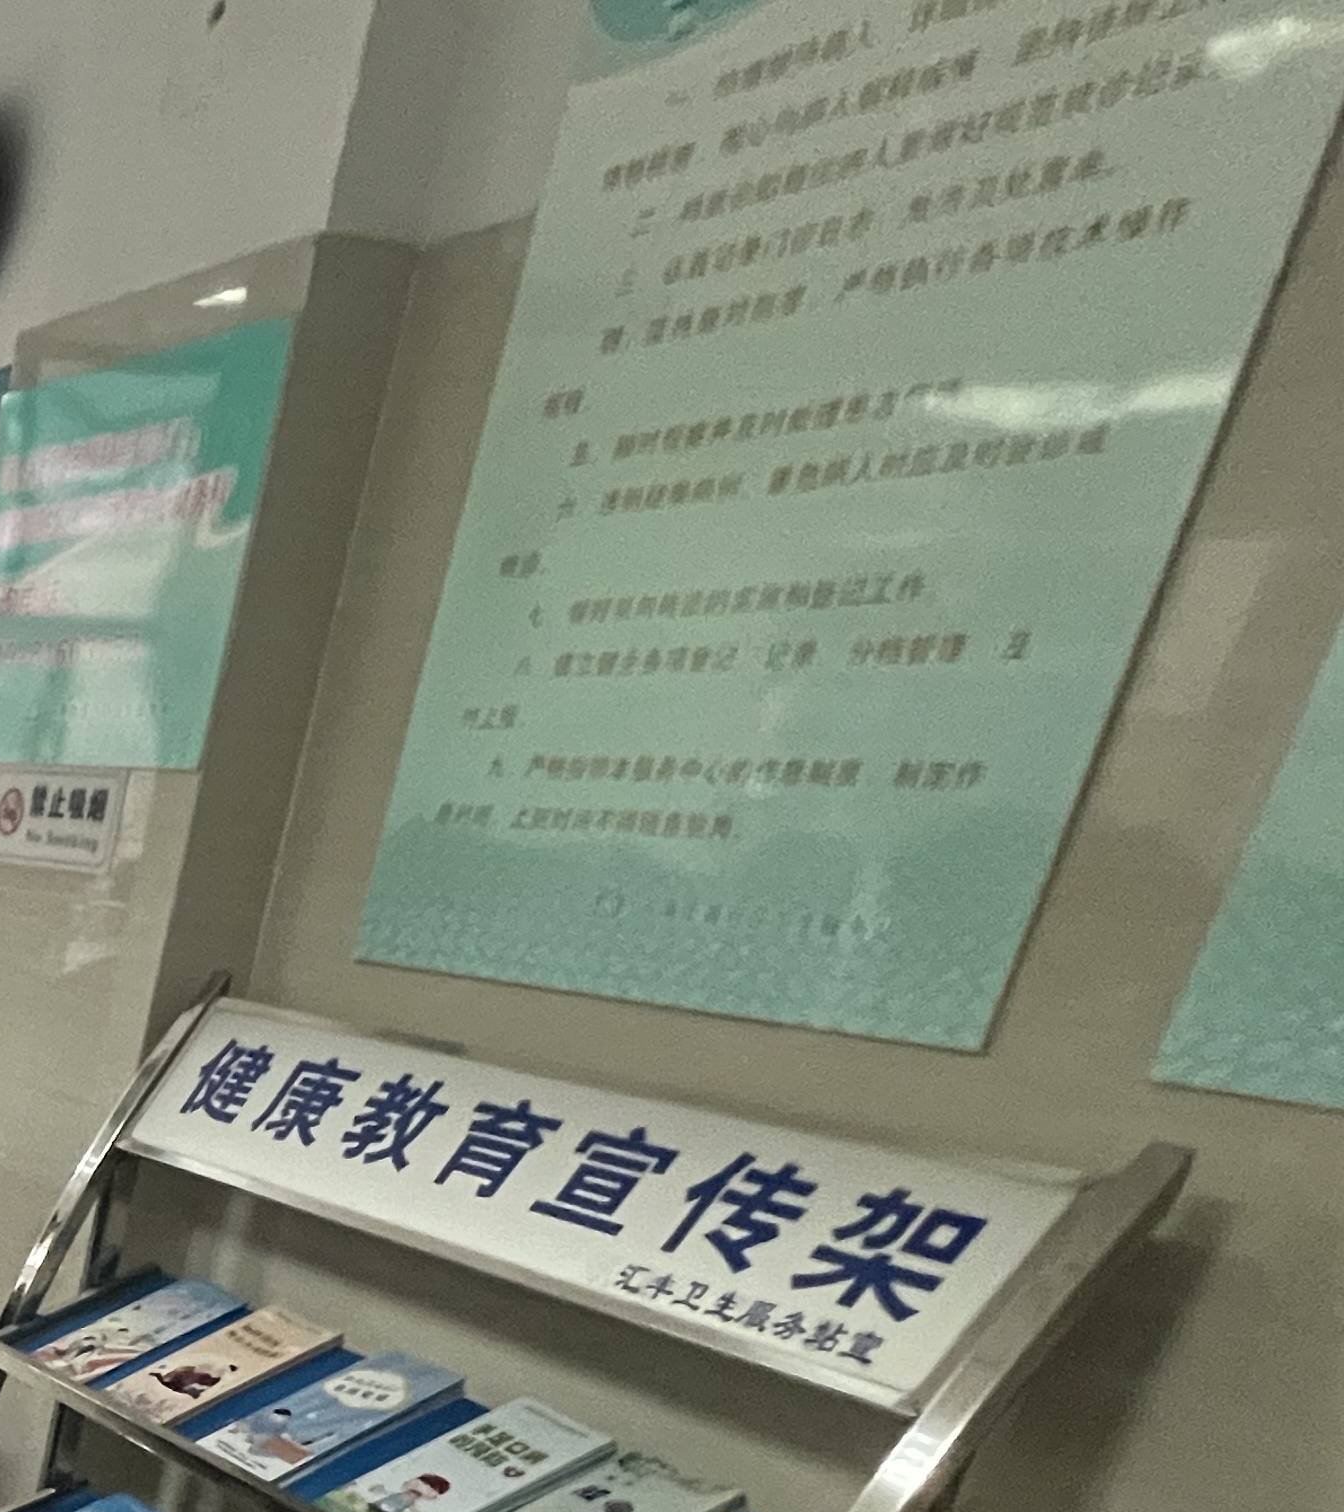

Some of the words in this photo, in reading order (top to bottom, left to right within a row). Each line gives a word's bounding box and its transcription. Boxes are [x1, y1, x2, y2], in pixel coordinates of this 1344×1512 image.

[30, 785, 109, 822] 禁止吸烟
[179, 1038, 988, 1322] 健康教育宣传架
